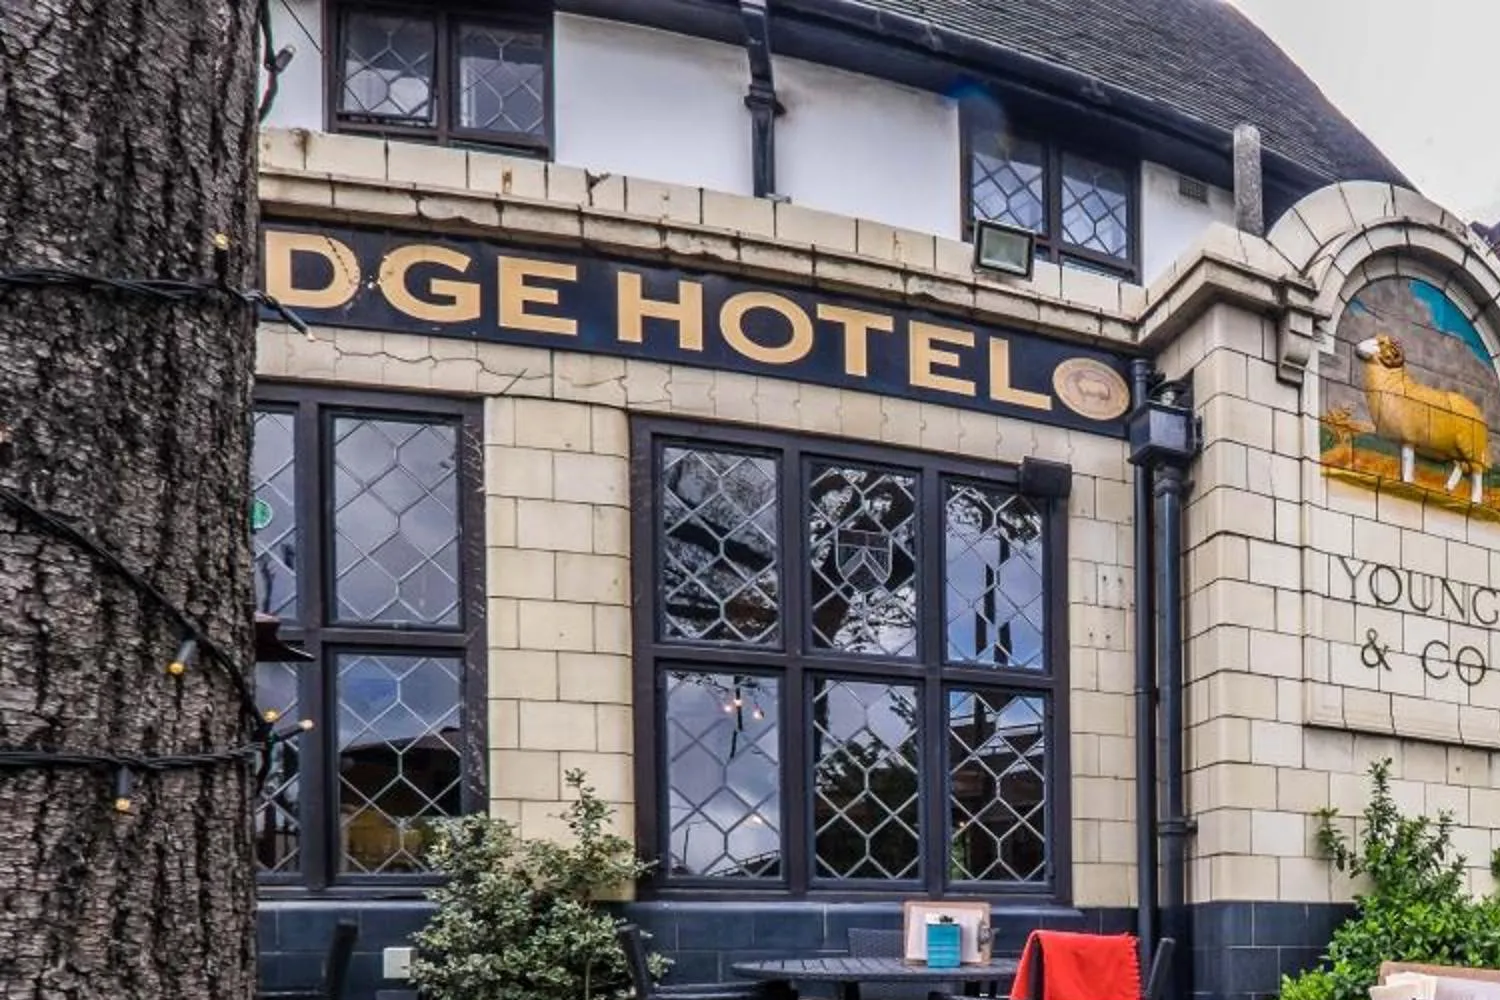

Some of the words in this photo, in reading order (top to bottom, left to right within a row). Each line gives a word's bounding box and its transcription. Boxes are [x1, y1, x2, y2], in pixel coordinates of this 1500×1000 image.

[264, 229, 579, 336] DGE
[616, 270, 1053, 412] HOTEL
[1336, 554, 1500, 626] YOUNG
[1361, 628, 1393, 673] &
[1421, 639, 1486, 686] CO
